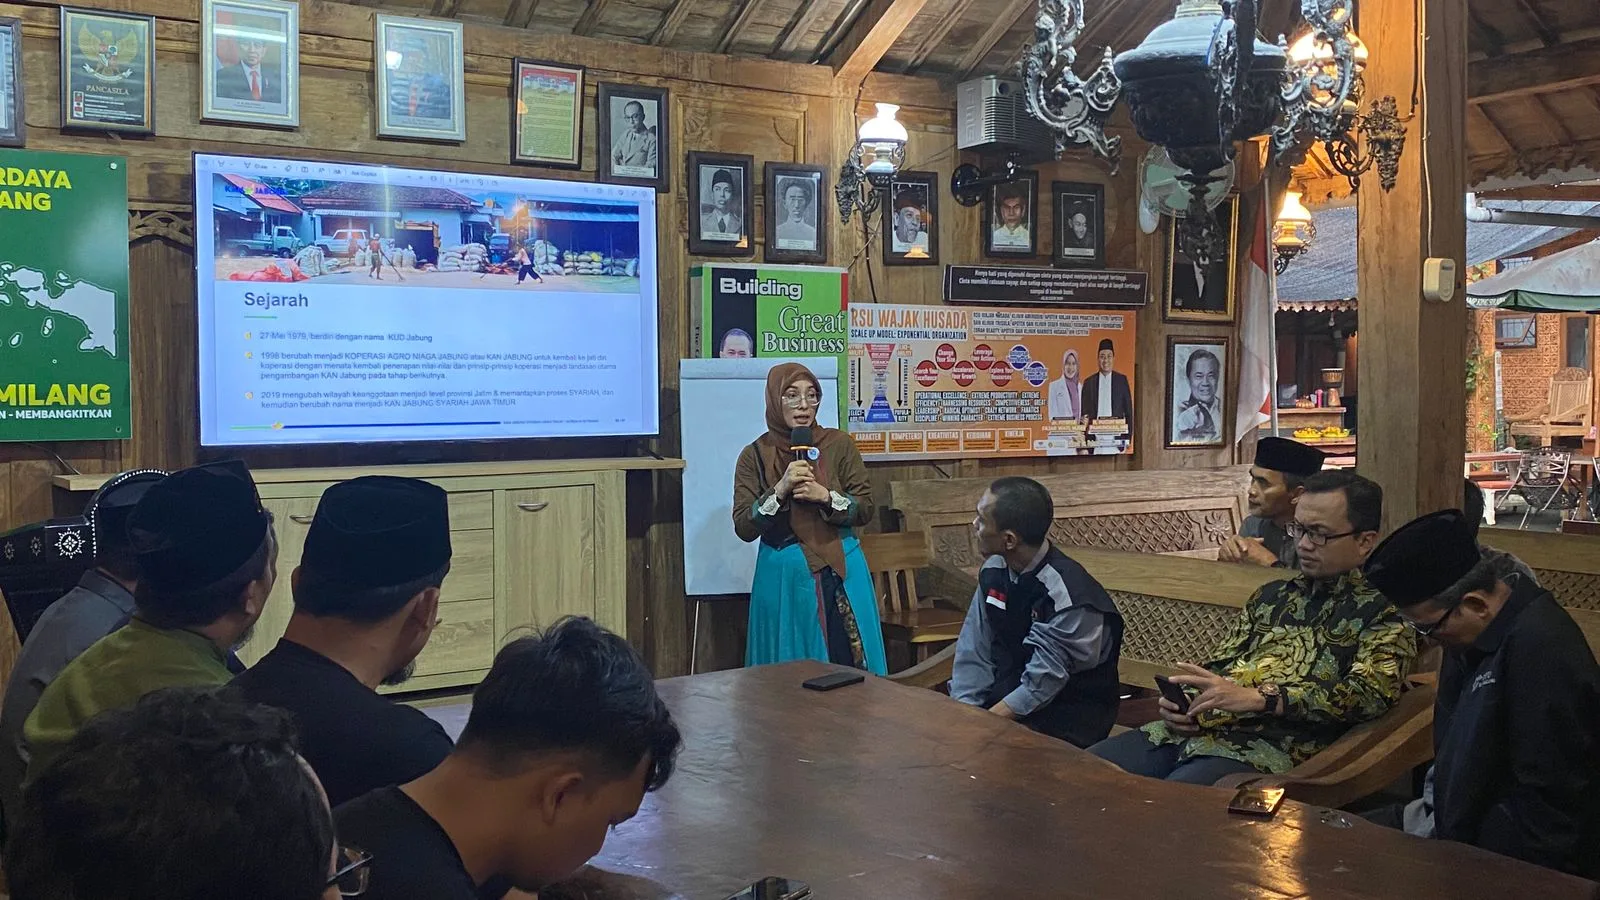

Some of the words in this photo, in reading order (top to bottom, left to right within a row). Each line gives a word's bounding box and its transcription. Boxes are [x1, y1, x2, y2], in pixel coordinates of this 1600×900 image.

[87, 85, 129, 95] PANCASILA
[720, 278, 802, 300] Building
[244, 292, 308, 309] Sejarah
[779, 306, 845, 333] Great
[851, 309, 873, 327] RSU
[878, 309, 919, 328] WAJAK
[923, 311, 967, 329] HUSADA
[260, 332, 269, 340] 27
[288, 332, 308, 341] 1979,
[335, 333, 362, 342] dengan
[406, 334, 432, 343] Jabung
[851, 329, 867, 338] SCALE
[869, 330, 876, 338] UP
[877, 330, 896, 338] MODEL:
[897, 330, 930, 339] EXPONENTIAL
[932, 331, 967, 339] ORGANIZATION
[762, 332, 844, 353] Business
[314, 352, 343, 362] menjadi
[260, 362, 292, 370] koperasi
[295, 362, 322, 370] dengan
[543, 363, 567, 371] menjadi
[340, 372, 366, 380] Jabung
[369, 372, 386, 380] pada
[388, 372, 408, 380] tahap
[0, 384, 110, 406] MILANG
[283, 392, 322, 400] mengubah
[324, 392, 350, 400] wilayah
[352, 391, 398, 399] keanggotaan
[447, 390, 472, 398] provinsi
[500, 390, 545, 398] memantapkan
[355, 401, 383, 409] menjadi
[16, 409, 112, 419] MEMBANGKITKAN
[891, 432, 922, 440] KOMPETENSI
